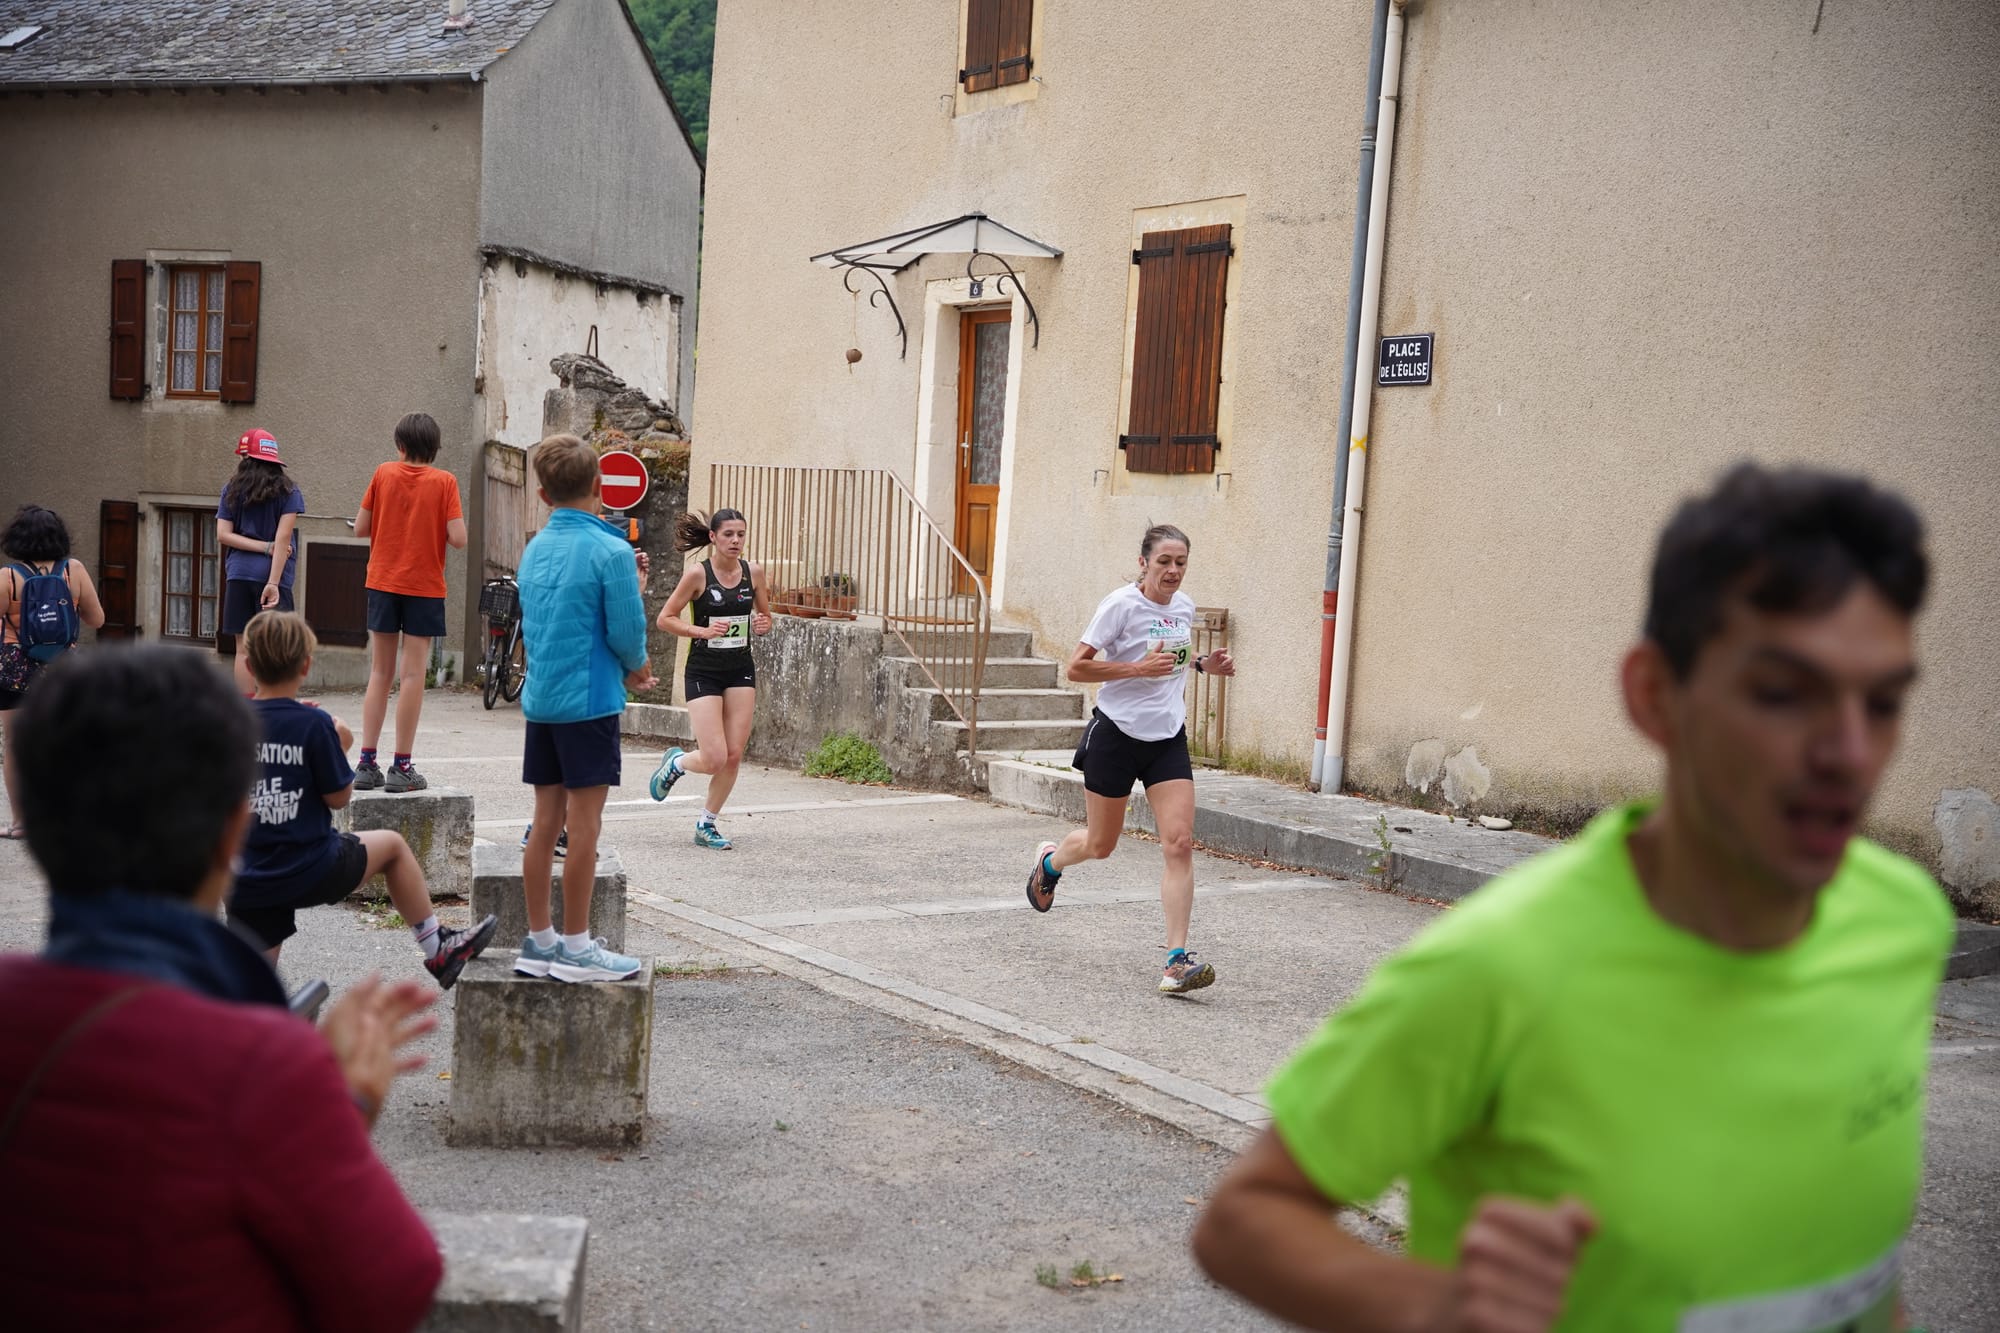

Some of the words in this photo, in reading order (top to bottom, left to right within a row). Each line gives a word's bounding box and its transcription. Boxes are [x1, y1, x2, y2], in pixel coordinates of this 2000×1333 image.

[973, 284, 979, 295] 6
[1389, 342, 1421, 357] PLACE
[1380, 366, 1390, 378] DE
[1391, 360, 1428, 377] L'ÉGLISE
